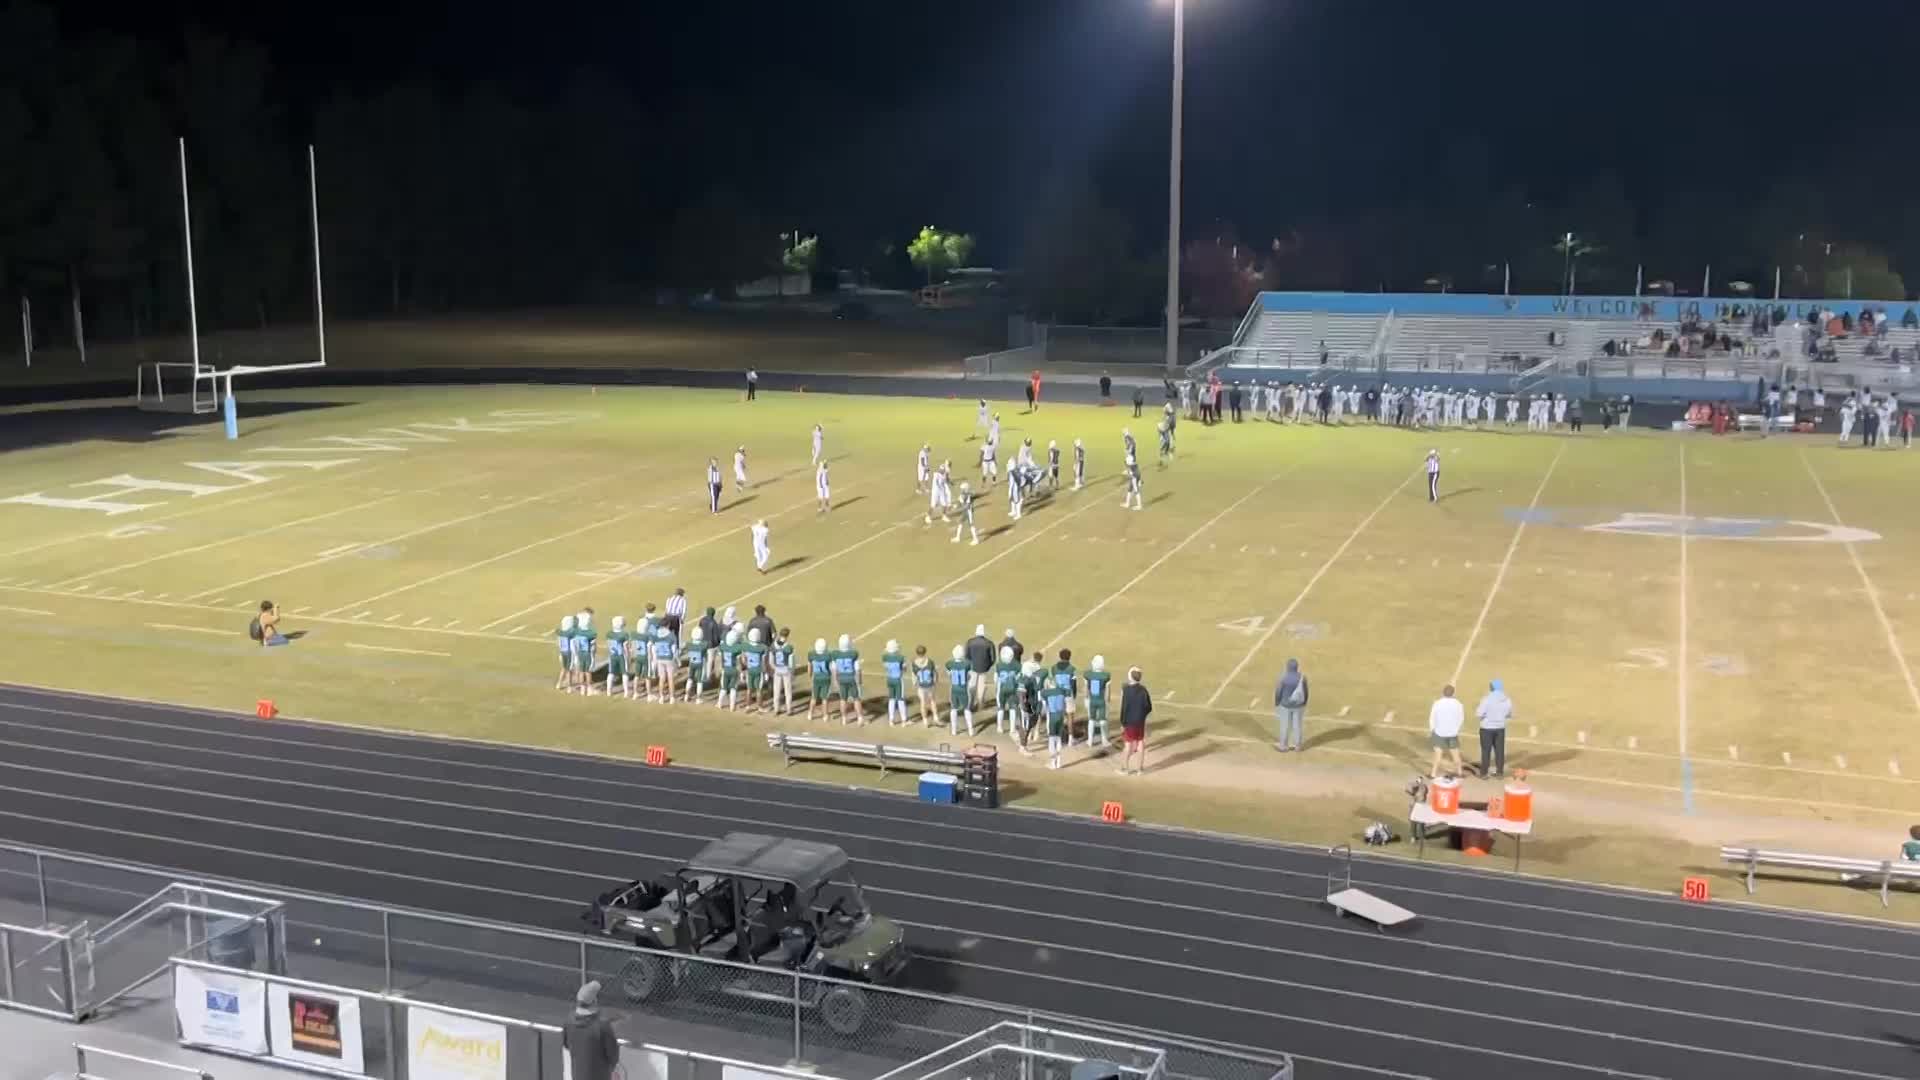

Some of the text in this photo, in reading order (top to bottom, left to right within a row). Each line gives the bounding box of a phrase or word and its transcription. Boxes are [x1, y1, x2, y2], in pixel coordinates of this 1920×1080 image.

[4, 409, 604, 516] HAWKS
[1104, 803, 1120, 821] 40
[1686, 880, 1705, 899] 50
